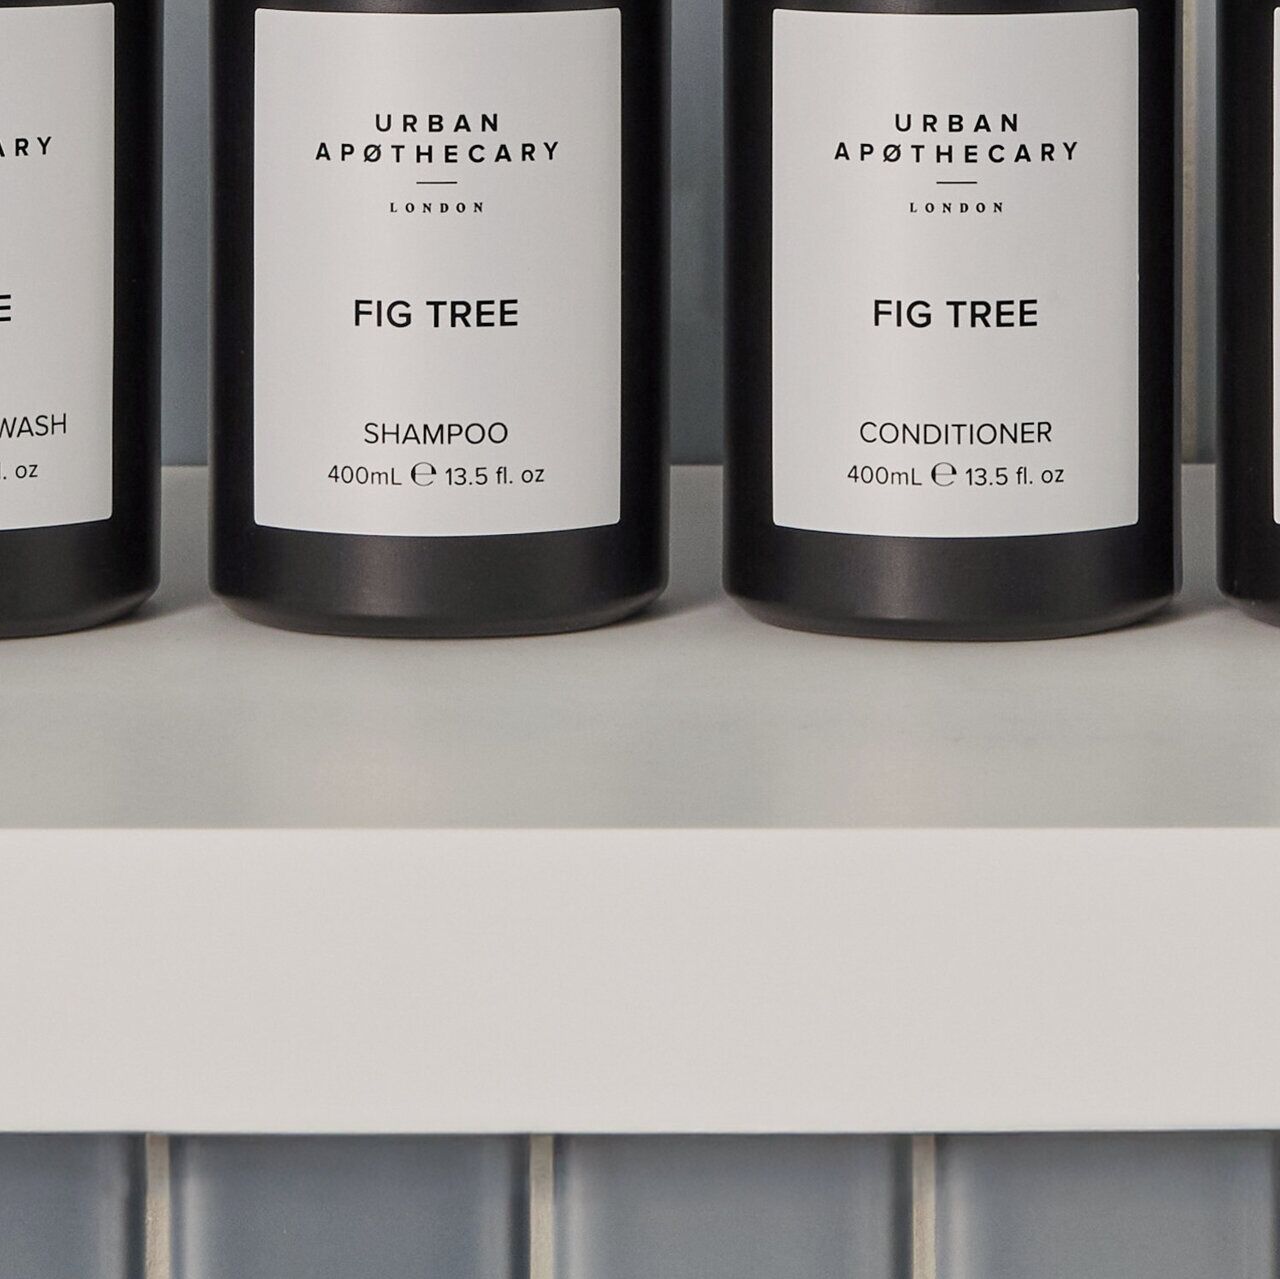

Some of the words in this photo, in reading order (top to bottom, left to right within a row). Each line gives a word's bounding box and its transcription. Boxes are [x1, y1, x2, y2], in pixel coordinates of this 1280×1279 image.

[375, 112, 498, 133] URBAN
[894, 113, 1018, 133] URBAN
[314, 140, 559, 164] APØTHECARY
[833, 140, 1079, 164] APØTHECARY
[389, 201, 484, 214] LONDON
[909, 201, 1003, 214] LONDON
[354, 298, 412, 329] FIG
[425, 298, 519, 329] TREE
[873, 298, 932, 329] FIG
[945, 298, 1038, 329] TREE
[363, 421, 509, 445] SHAMPOO
[859, 420, 1053, 446] CONDITIONER
[14, 463, 39, 480] oz
[327, 464, 403, 486] 400mL
[444, 466, 489, 486] 13.5
[495, 465, 514, 485] fl.
[520, 468, 545, 484] oz
[846, 464, 923, 487] 400mL
[965, 466, 1009, 487] 13.5
[1015, 465, 1034, 485] fl.
[1040, 468, 1065, 485] oz
